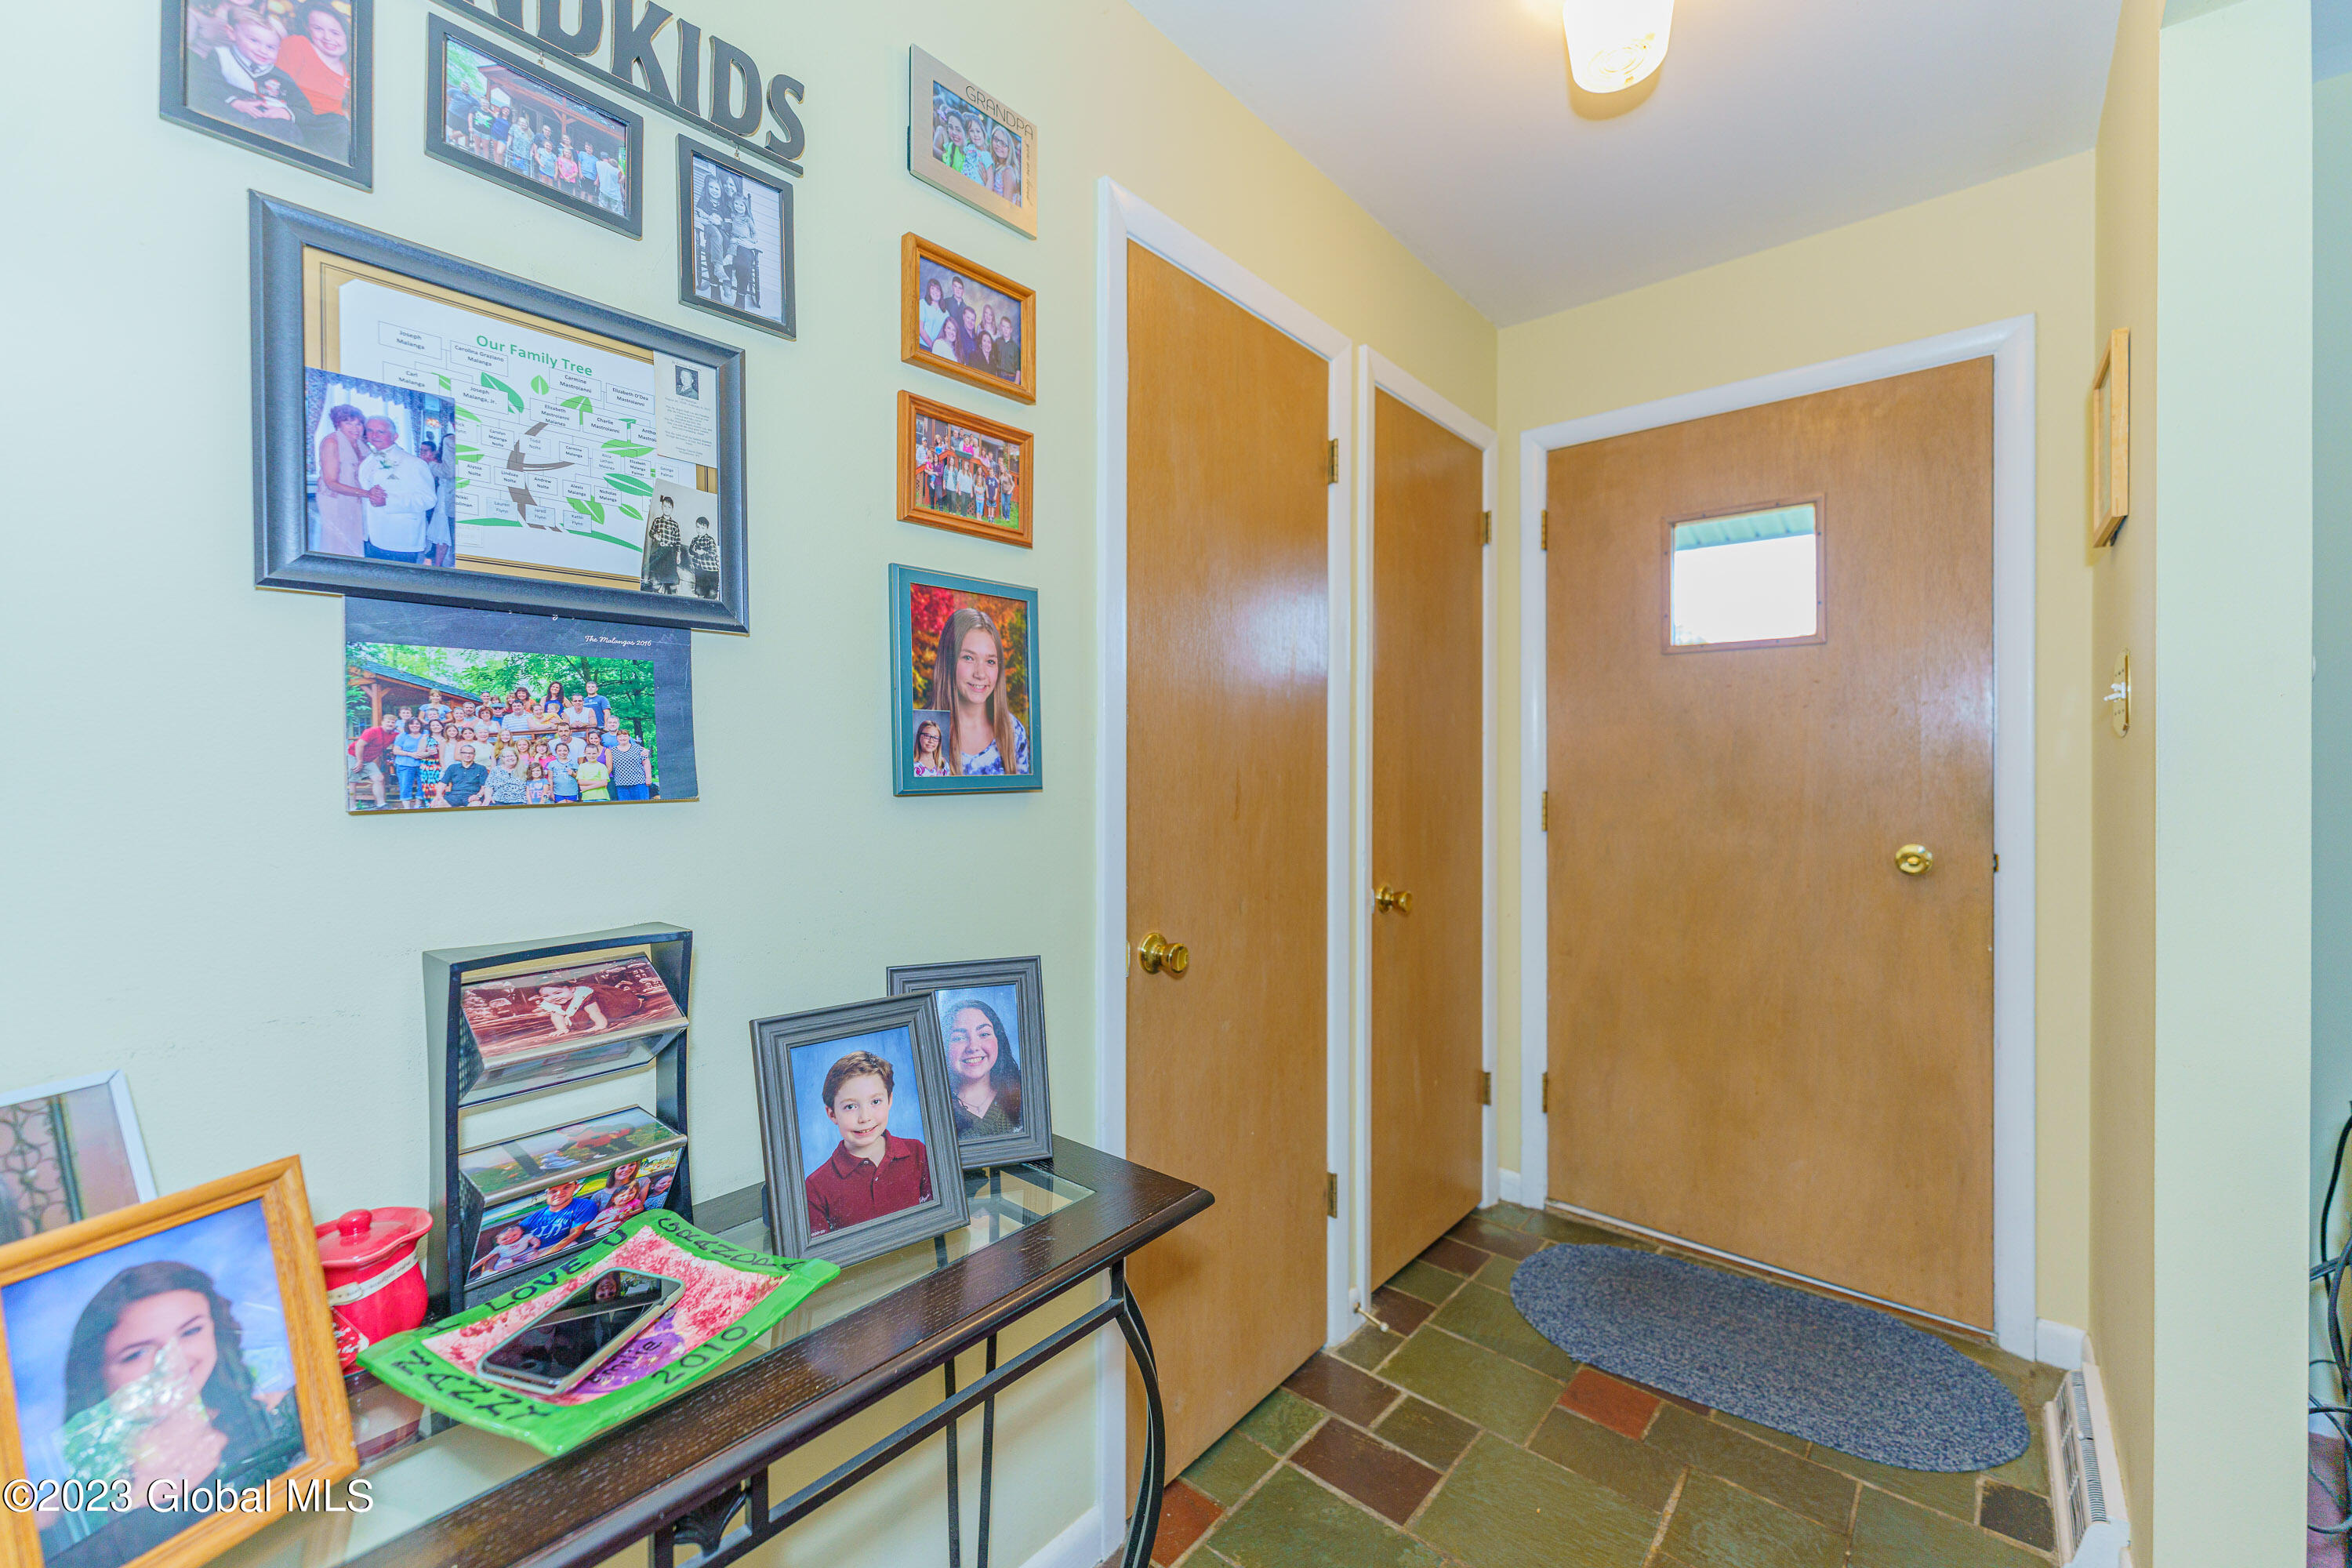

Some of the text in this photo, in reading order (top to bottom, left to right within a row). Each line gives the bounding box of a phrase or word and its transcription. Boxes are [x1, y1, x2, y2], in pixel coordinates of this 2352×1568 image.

[463, 0, 805, 160] DKIDS
[966, 85, 1033, 140] GRANDPA
[399, 330, 422, 340] Joseph
[396, 338, 425, 350] Malanga
[455, 345, 505, 362] Carolina Graziano
[477, 335, 593, 376] Our Family Tree
[467, 356, 492, 367] Malanga
[398, 377, 425, 387] Malanga
[564, 374, 587, 384] Carmine
[470, 386, 490, 395] Joseph
[559, 380, 592, 394] Mastroianni
[612, 387, 633, 397] Elizabeth
[463, 393, 489, 404] Malanga,
[616, 395, 645, 407] Mastroianni
[544, 404, 566, 413] Elizabeth
[541, 410, 570, 421] Mastroianni
[545, 418, 566, 427] Malanga
[591, 423, 620, 434] Mastroianni
[488, 434, 507, 443] Malanga
[599, 636, 635, 647] Malangas
[485, 1258, 591, 1312] LOVE
[602, 1229, 628, 1247] U
[651, 1326, 748, 1385] 2010
